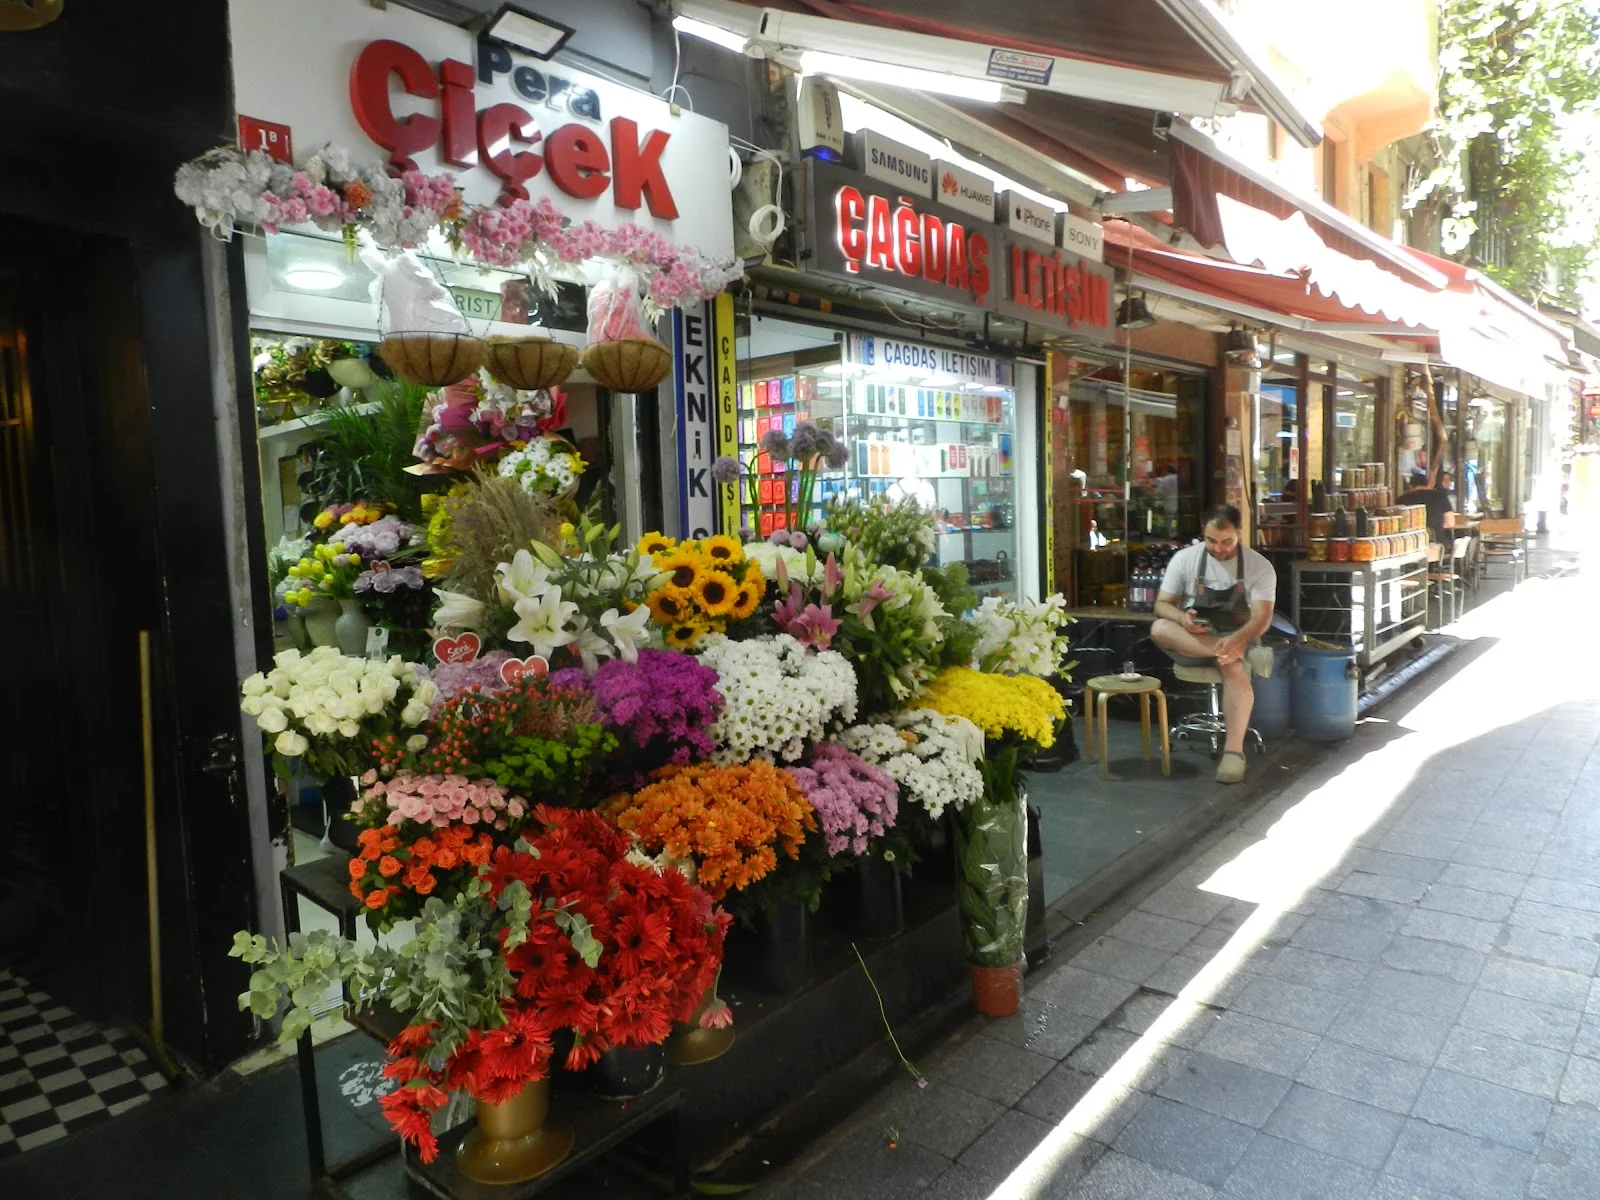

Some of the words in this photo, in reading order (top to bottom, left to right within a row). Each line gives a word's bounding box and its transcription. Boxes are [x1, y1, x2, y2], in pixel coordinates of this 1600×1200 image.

[475, 36, 603, 123] Pera
[871, 147, 928, 184] SAMSUNG
[960, 185, 993, 206] HUAWEI
[1024, 207, 1051, 232] iPhone
[835, 185, 990, 307] ÇAĞDAŞ
[1069, 228, 1099, 250] SONY
[721, 336, 735, 507] ÇAĞDŞ
